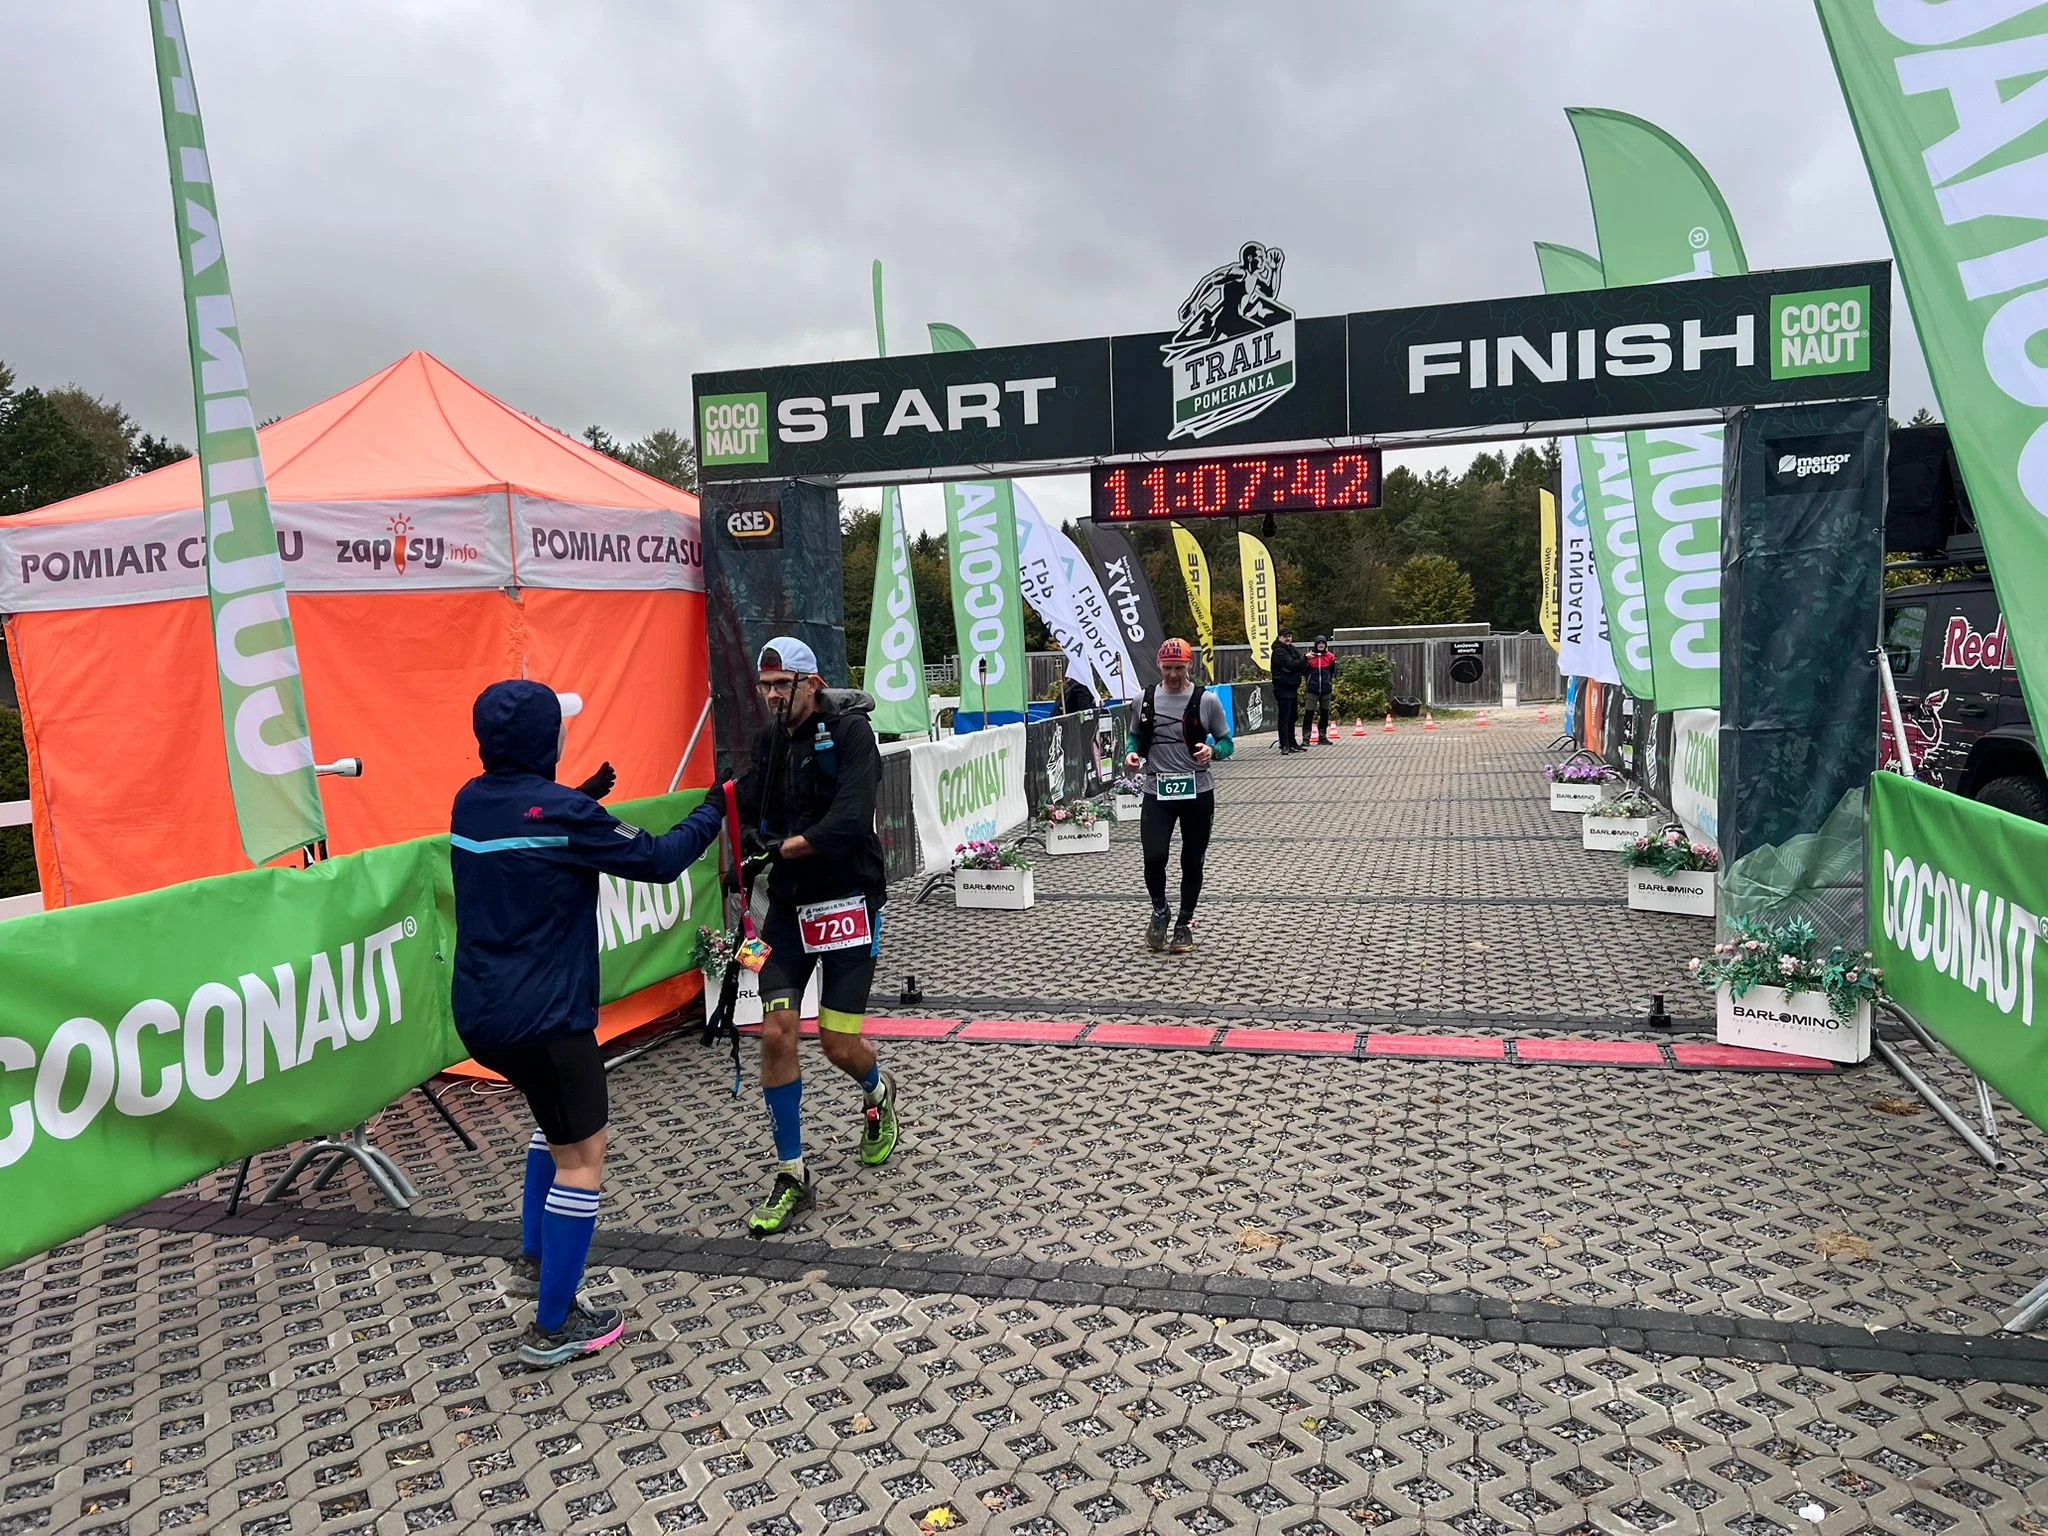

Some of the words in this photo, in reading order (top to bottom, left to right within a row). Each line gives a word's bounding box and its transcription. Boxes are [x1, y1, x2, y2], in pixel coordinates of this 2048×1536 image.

[1780, 300, 1860, 336] COCO
[1186, 332, 1281, 390] TRAIL
[1408, 314, 1754, 394] FINISH
[1781, 331, 1861, 367] NAUT
[777, 376, 1056, 443] START
[1194, 372, 1275, 412] POMERANIA
[705, 403, 759, 431] COCO
[705, 428, 760, 457] NAUT
[1797, 453, 1851, 466] mercor
[1104, 454, 1368, 517] 11:07:42
[1797, 463, 1840, 477] group
[21, 542, 167, 583] POMIAR
[532, 527, 630, 563] POMIAR
[641, 534, 703, 568] CZASU
[1942, 613, 2006, 671] Red
[1165, 781, 1187, 794] 627
[815, 916, 855, 941] 720
